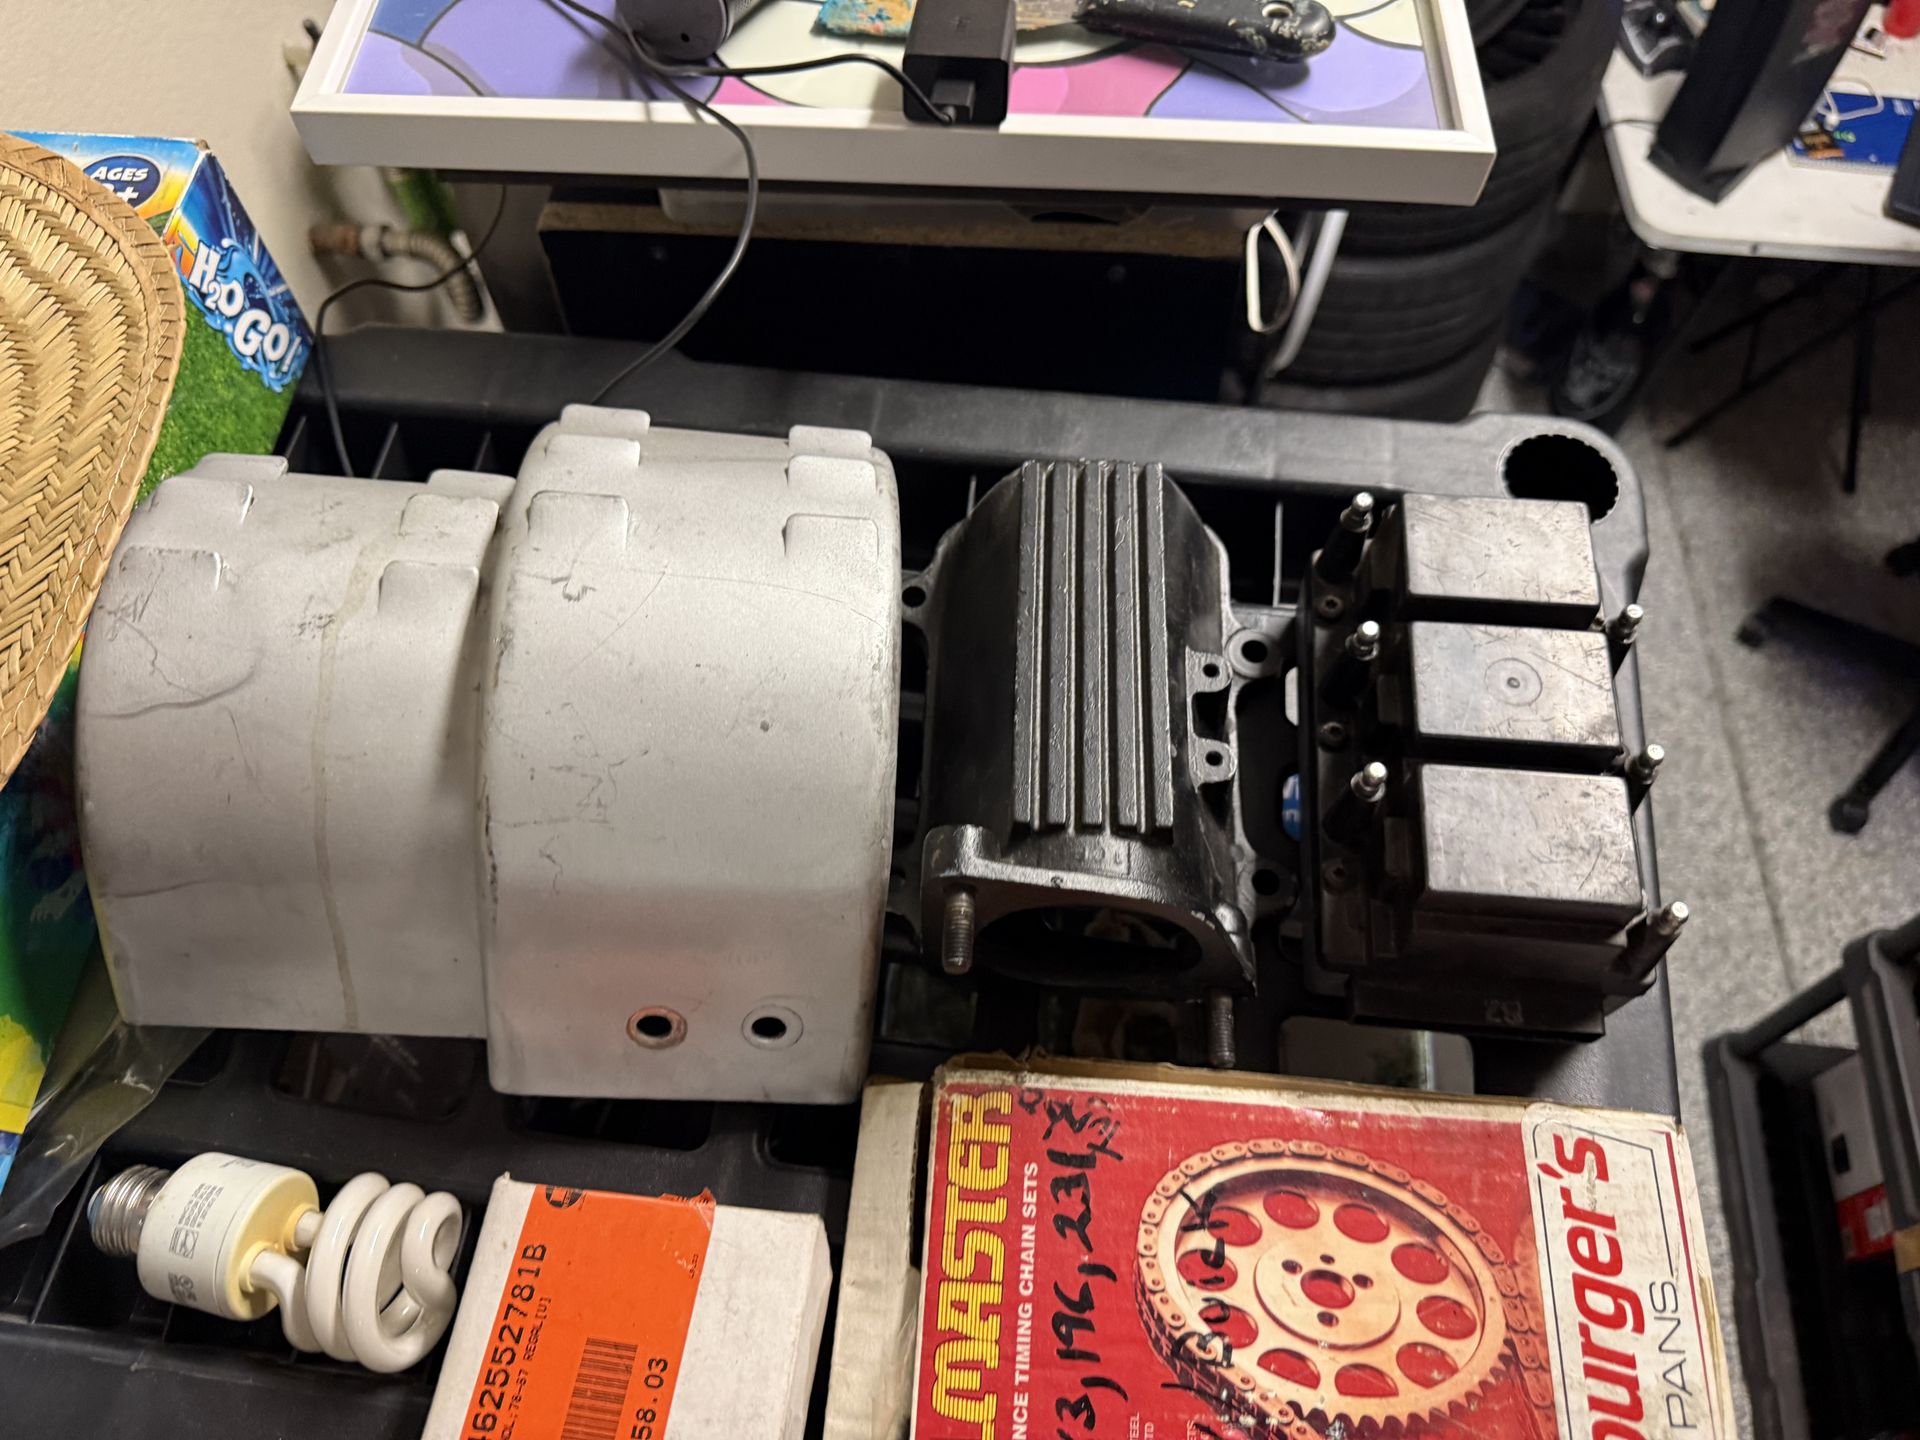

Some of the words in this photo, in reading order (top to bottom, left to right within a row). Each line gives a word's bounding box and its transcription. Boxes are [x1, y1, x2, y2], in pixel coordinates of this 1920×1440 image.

[90, 166, 149, 182] AGES
[1022, 1162, 1038, 1218] SETS
[932, 1091, 1012, 1440] MASTER
[1018, 1223, 1036, 1296] CHAIN
[467, 1243, 548, 1440] 62552781B
[1014, 1302, 1032, 1383] TIMING
[1649, 1281, 1698, 1429] PANS
